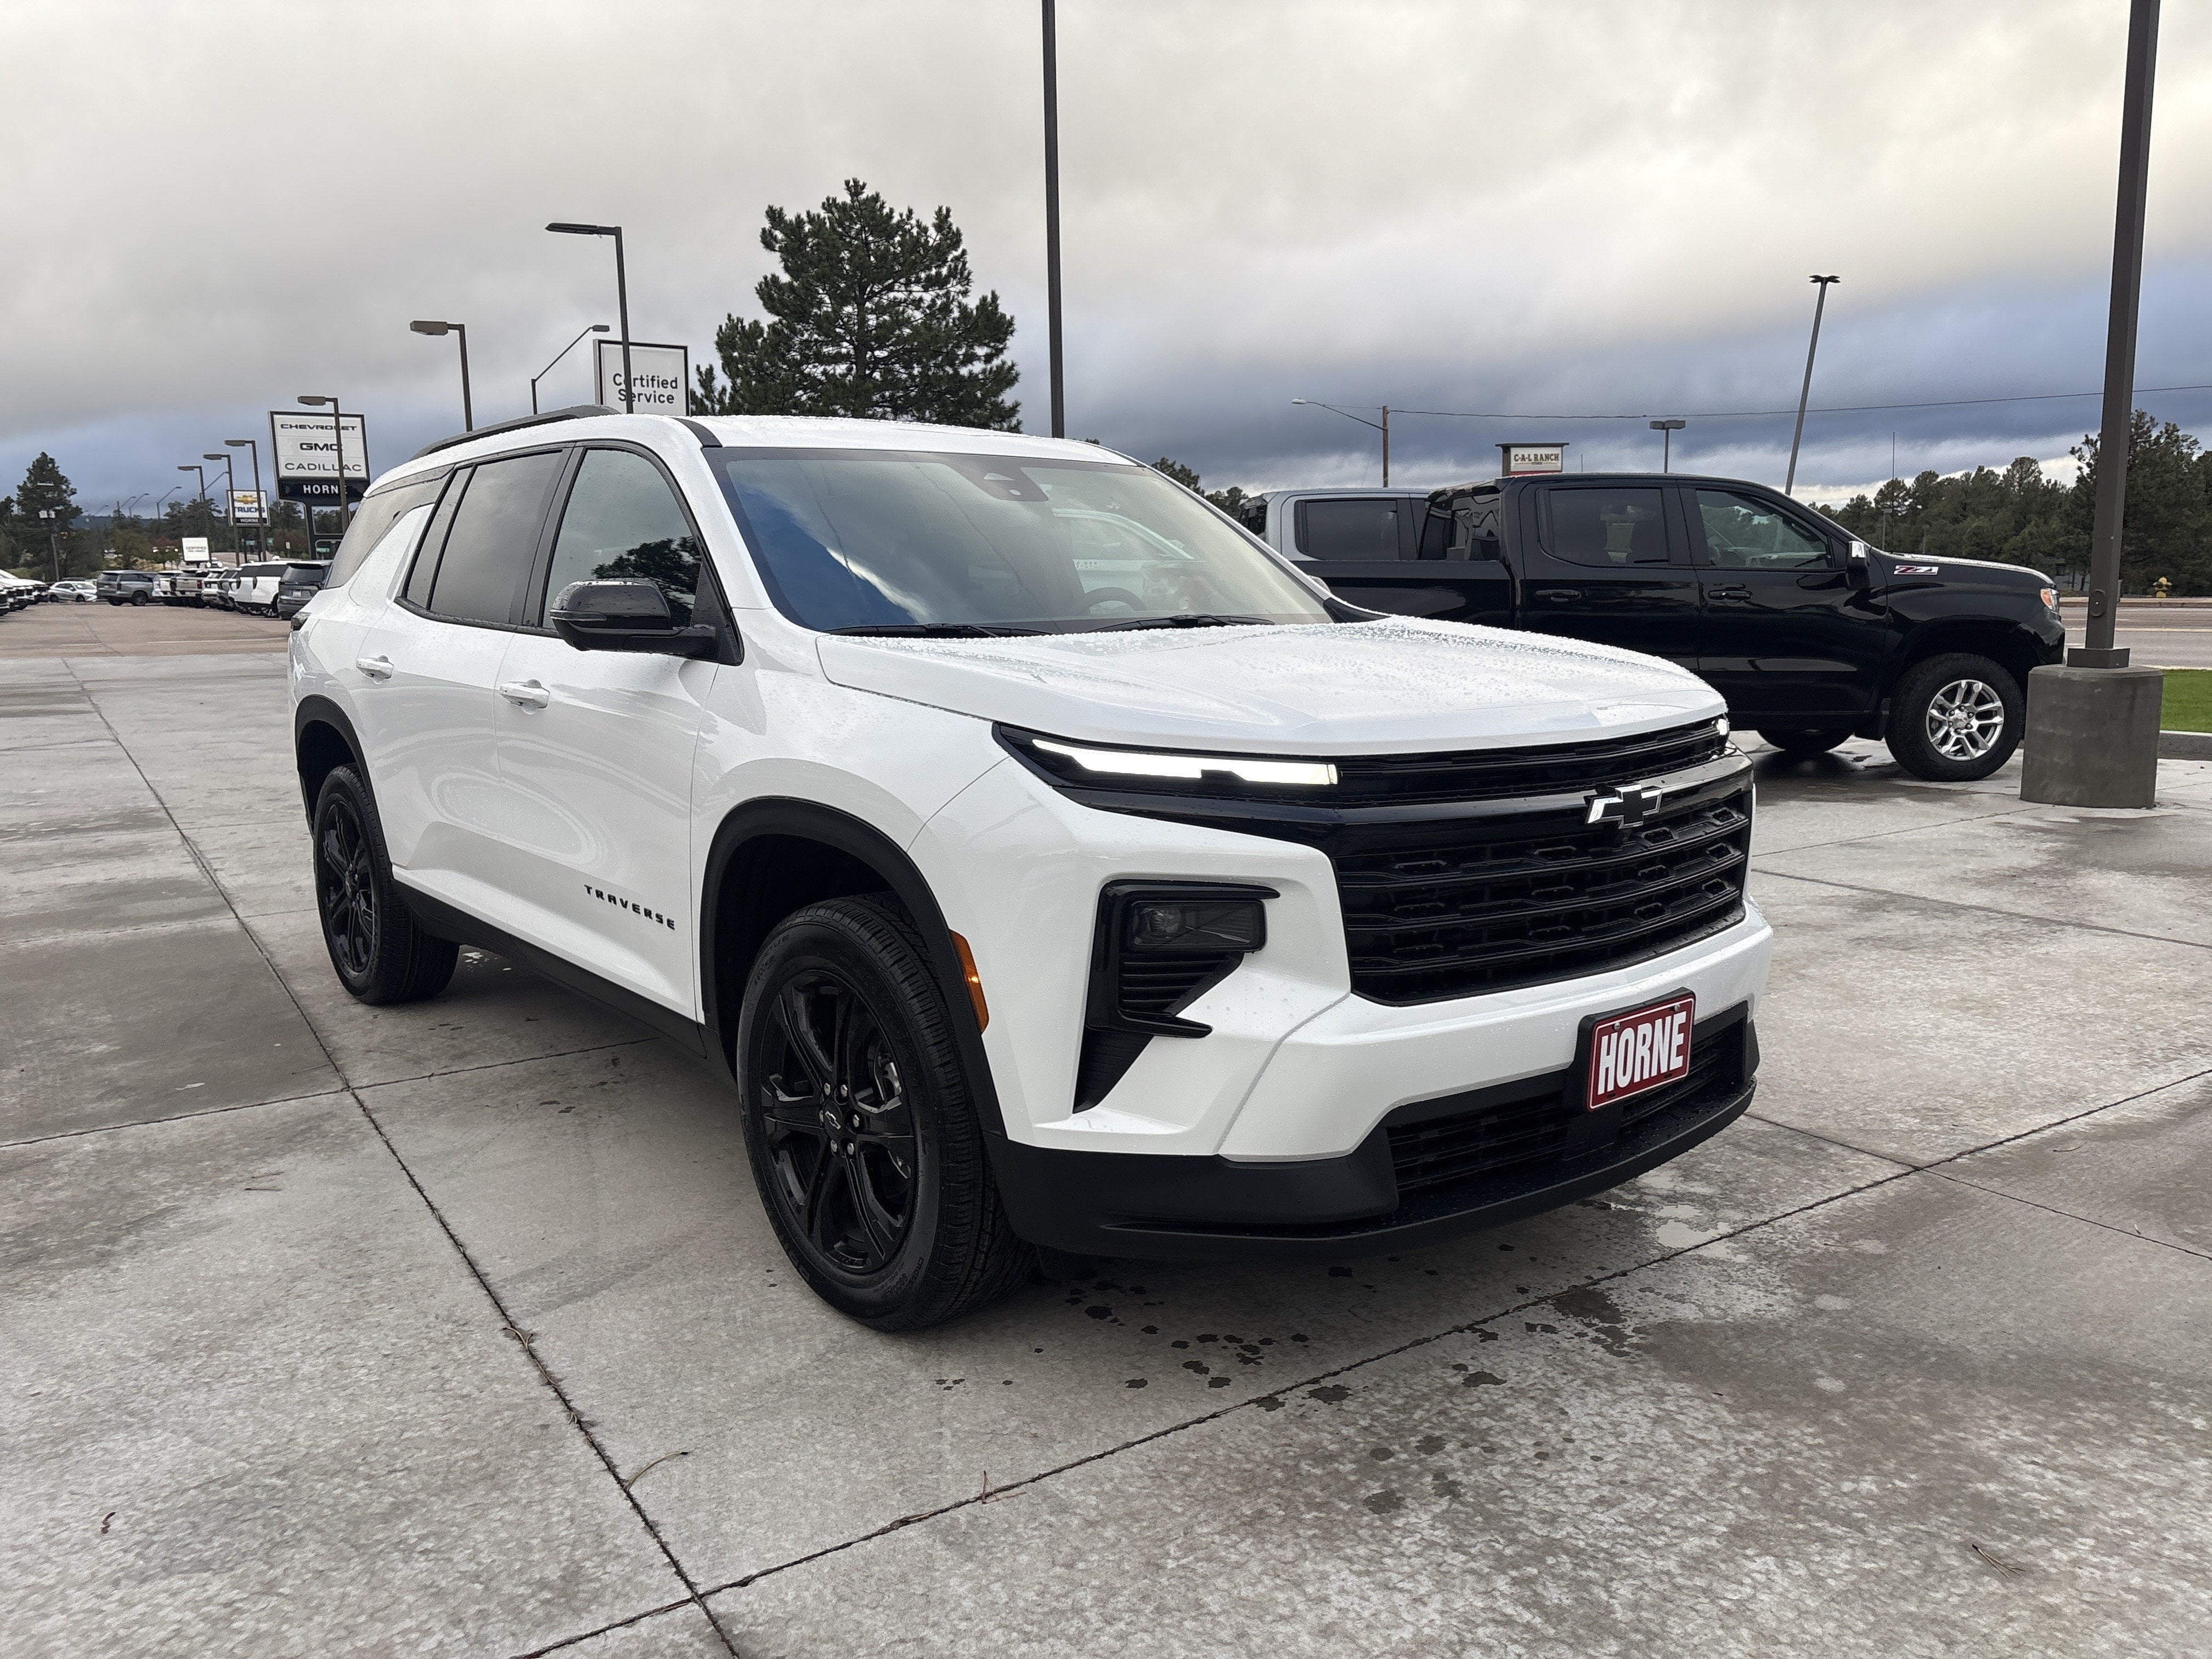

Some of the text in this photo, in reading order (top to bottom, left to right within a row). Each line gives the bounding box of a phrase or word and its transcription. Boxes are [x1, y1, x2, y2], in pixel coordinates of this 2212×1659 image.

[613, 373, 678, 389] Crtified
[300, 442, 343, 452] GMC
[1533, 453, 1559, 461] RANCH
[285, 462, 362, 471] CADILLAC
[303, 484, 347, 494] HORN
[1894, 565, 1939, 575] Z71
[584, 884, 675, 930] TRAVERSE
[1597, 1011, 1687, 1096] HORNE
